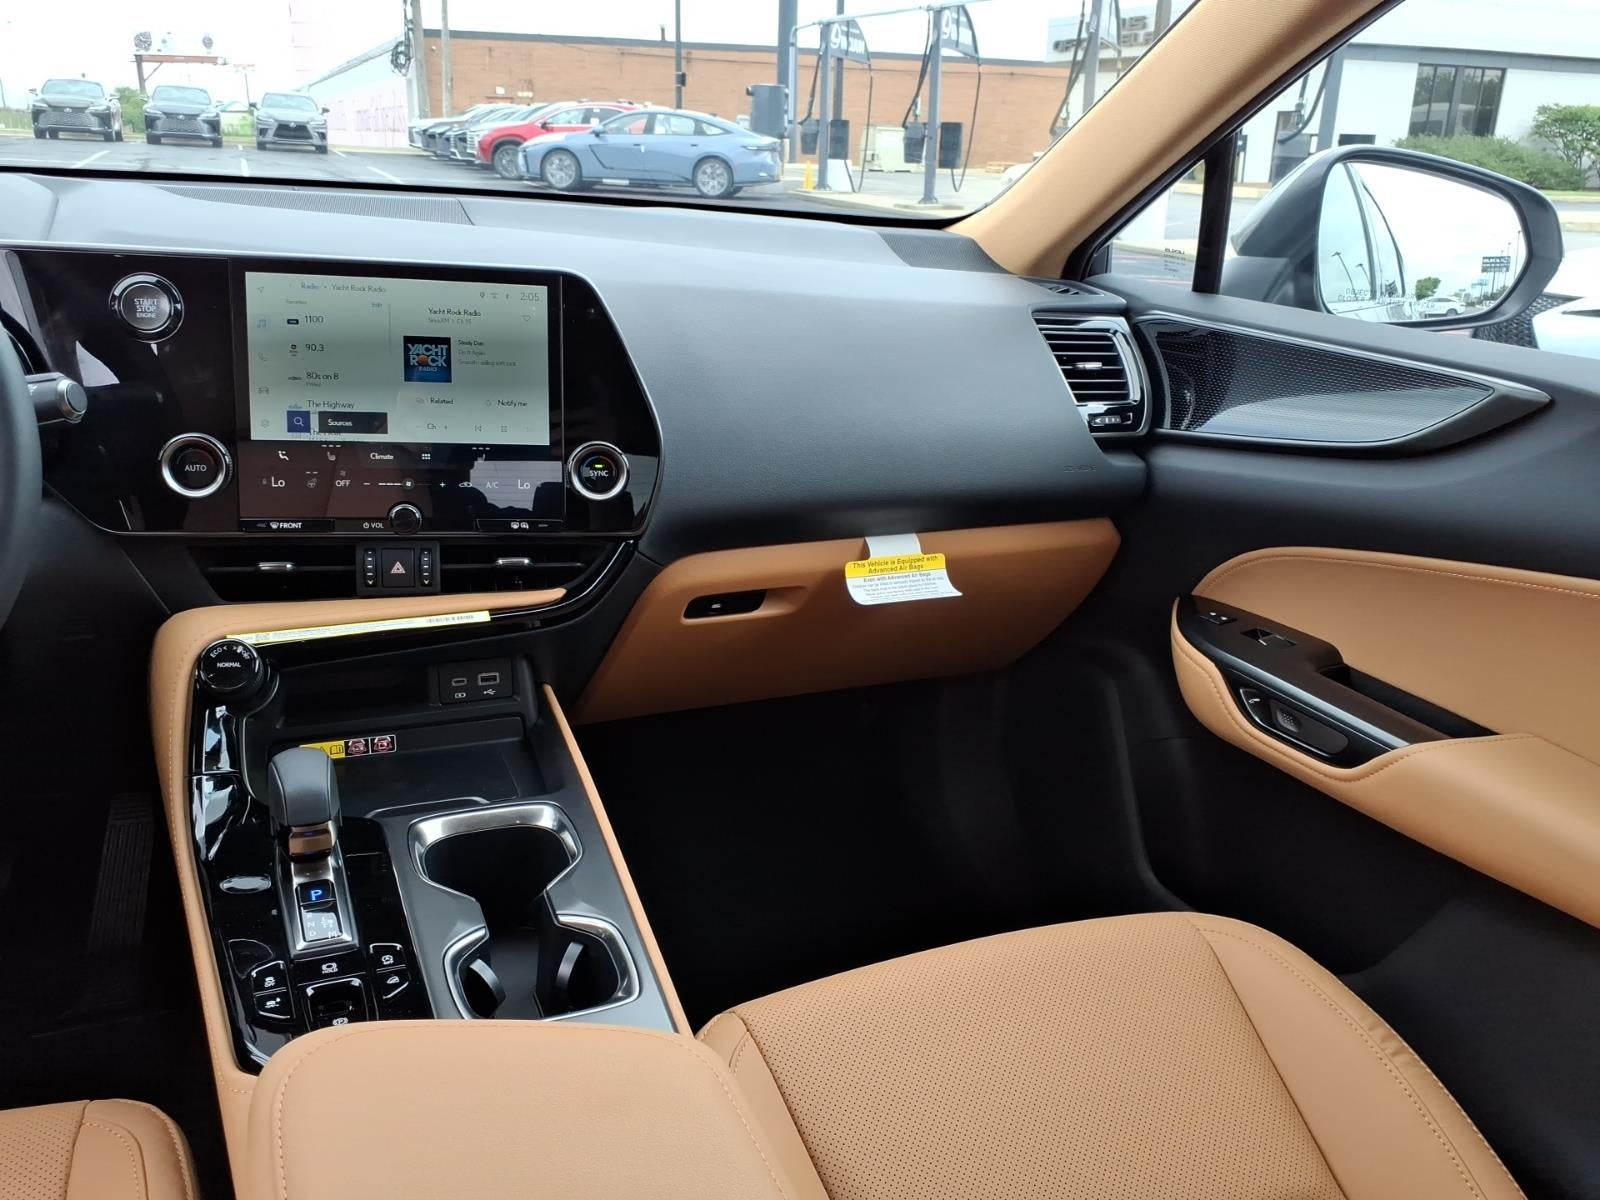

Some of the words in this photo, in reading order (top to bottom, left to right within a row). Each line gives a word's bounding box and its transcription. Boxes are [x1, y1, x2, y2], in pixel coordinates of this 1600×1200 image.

[301, 282, 319, 290] Radio
[331, 283, 350, 292] Yacht
[367, 285, 386, 293] Radio
[520, 292, 540, 301] 2:05
[134, 298, 158, 306] START
[428, 307, 446, 316] Yacht
[447, 308, 463, 316] Rock
[463, 309, 482, 317] Radio
[304, 315, 324, 324] 1100
[304, 343, 324, 352] 90.3
[407, 343, 448, 356] YACHT
[409, 354, 448, 367] ROCK
[306, 372, 321, 381] 80s
[307, 400, 322, 409] The
[323, 401, 355, 411] Highway
[430, 397, 454, 405] Related
[497, 399, 517, 409] Notify
[328, 418, 353, 427] Sources
[370, 452, 394, 461] Climate
[184, 464, 207, 472] AUTO
[589, 469, 609, 477] SYNC
[271, 476, 286, 488] Lo
[335, 479, 351, 488] OFF
[485, 481, 499, 489] A/C
[517, 479, 531, 490] Lo
[279, 521, 302, 530] FRONT
[371, 521, 384, 529] VOL
[868, 560, 889, 568] Vehicle
[896, 557, 925, 566] Equipped
[868, 565, 898, 574] Advanced
[909, 563, 924, 571] Bags
[210, 647, 222, 658] ECO
[310, 889, 322, 901] P
